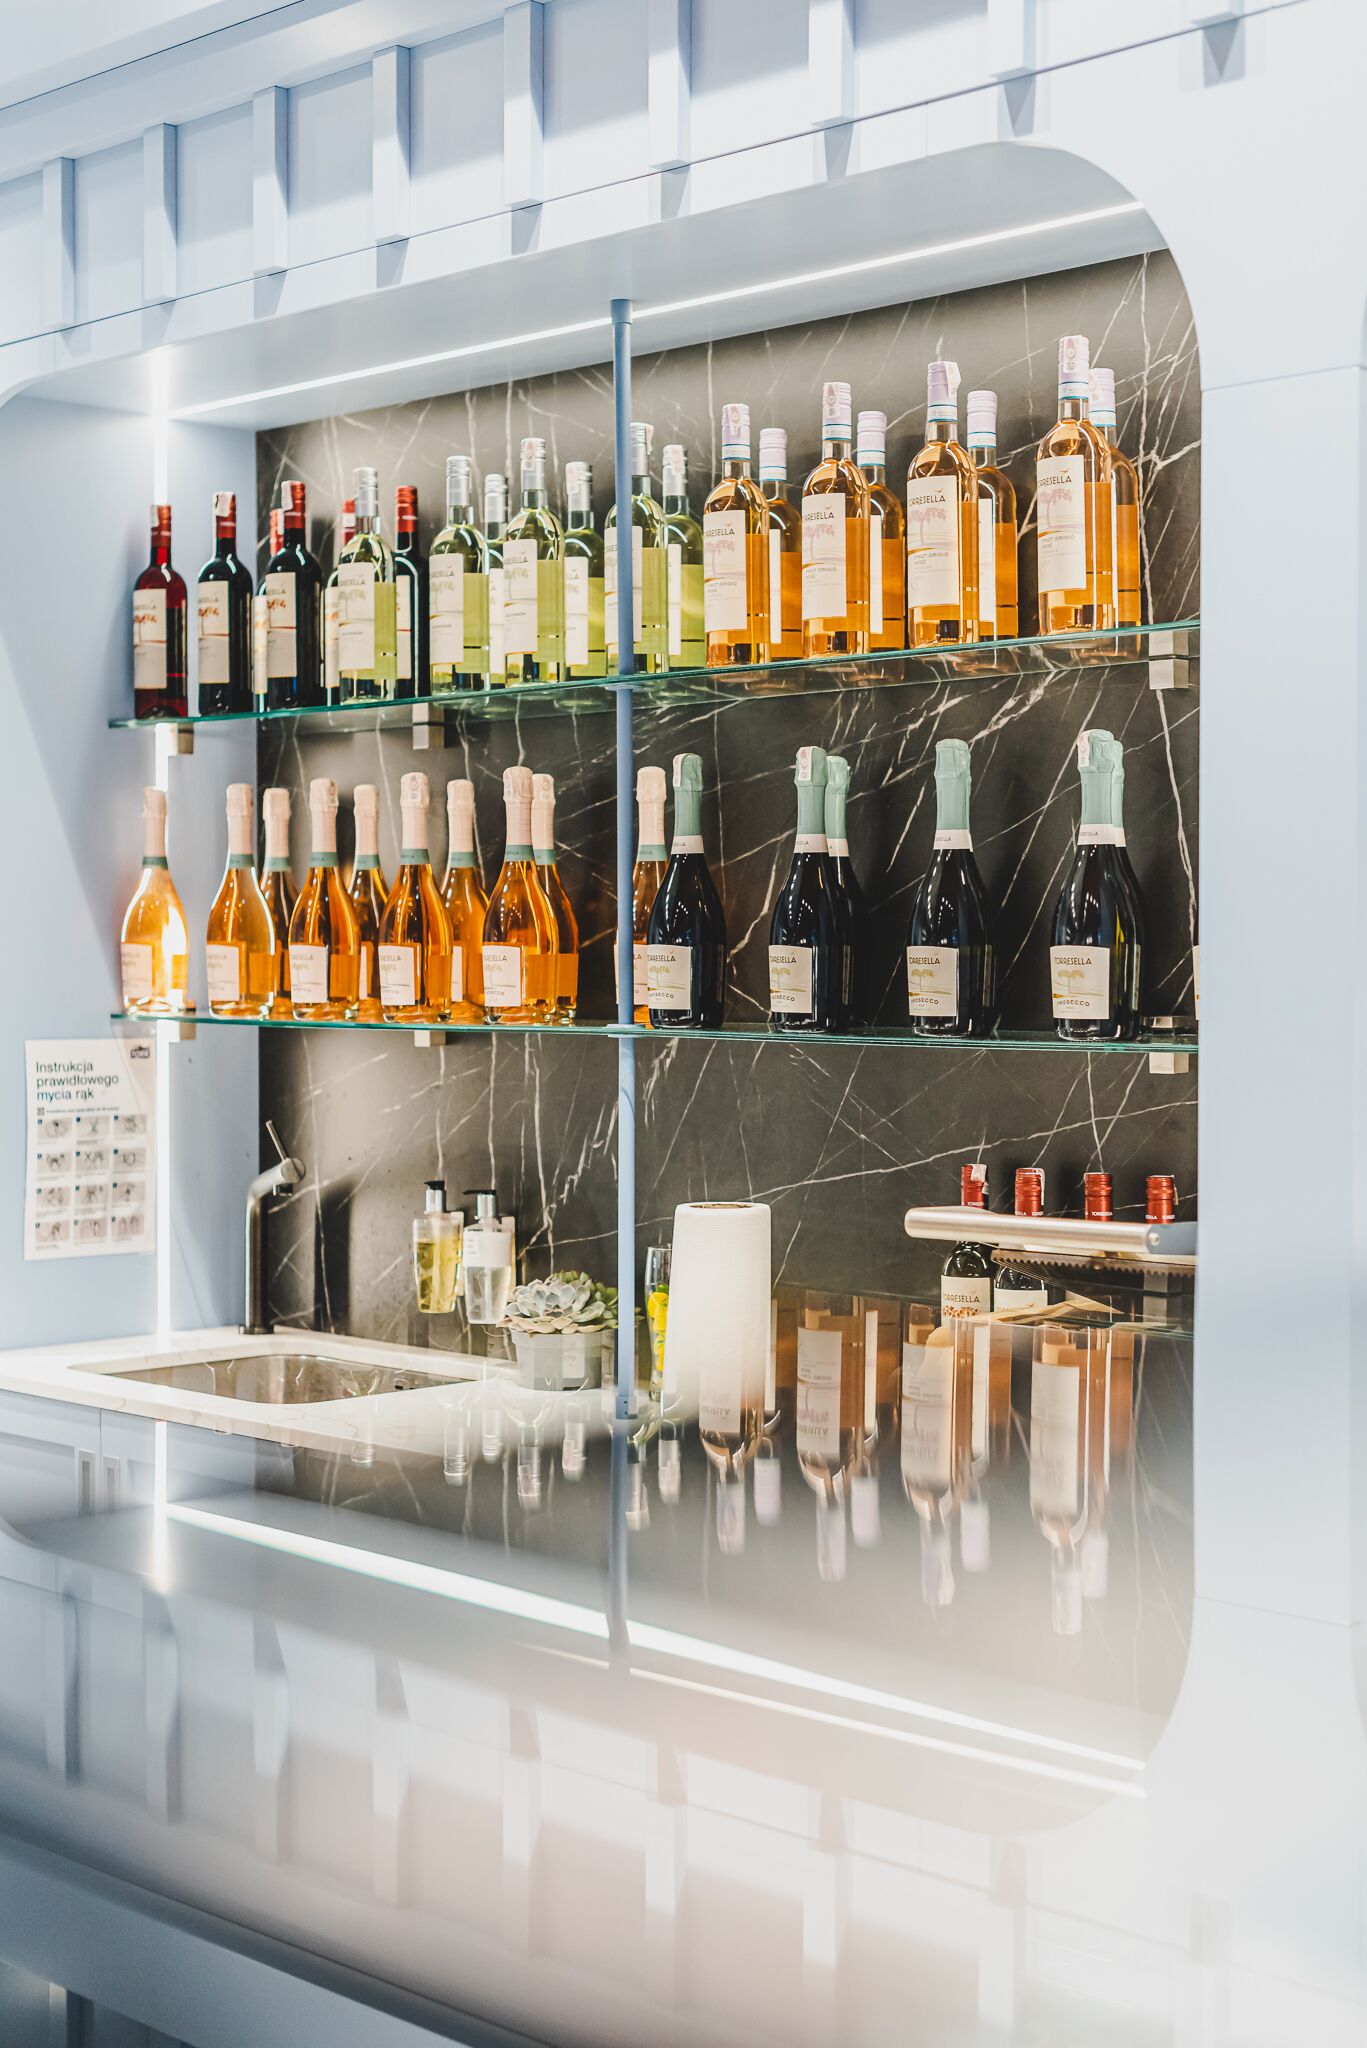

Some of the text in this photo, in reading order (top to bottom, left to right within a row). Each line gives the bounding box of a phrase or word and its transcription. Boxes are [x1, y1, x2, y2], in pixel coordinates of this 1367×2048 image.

[36, 1061, 93, 1074] Instrukcja
[37, 1075, 119, 1089] prawidłowego
[37, 1089, 94, 1103] mycia rąk
